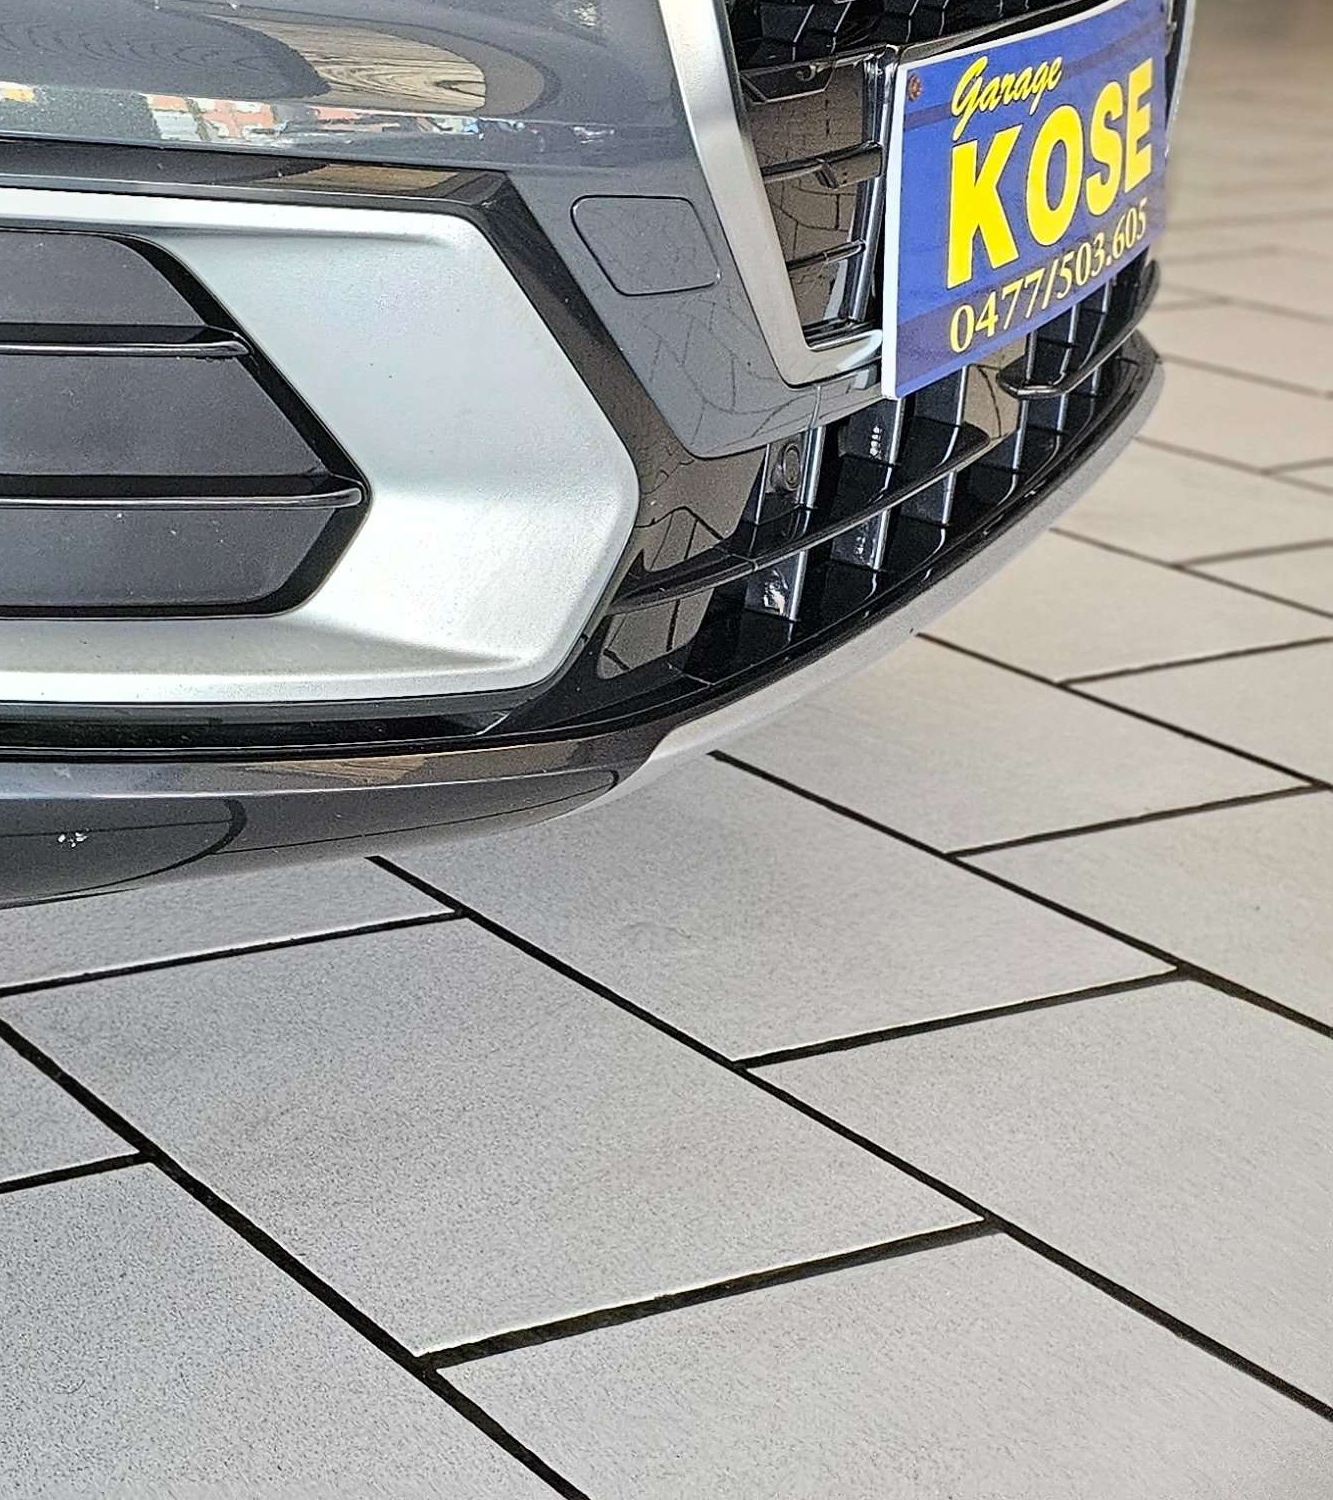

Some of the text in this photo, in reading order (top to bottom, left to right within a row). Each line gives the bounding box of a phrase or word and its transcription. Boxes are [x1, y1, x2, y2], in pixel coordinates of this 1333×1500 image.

[946, 58, 1153, 290] KOSE
[951, 56, 1062, 140] Garage
[950, 198, 1148, 353] 0477/503.605
